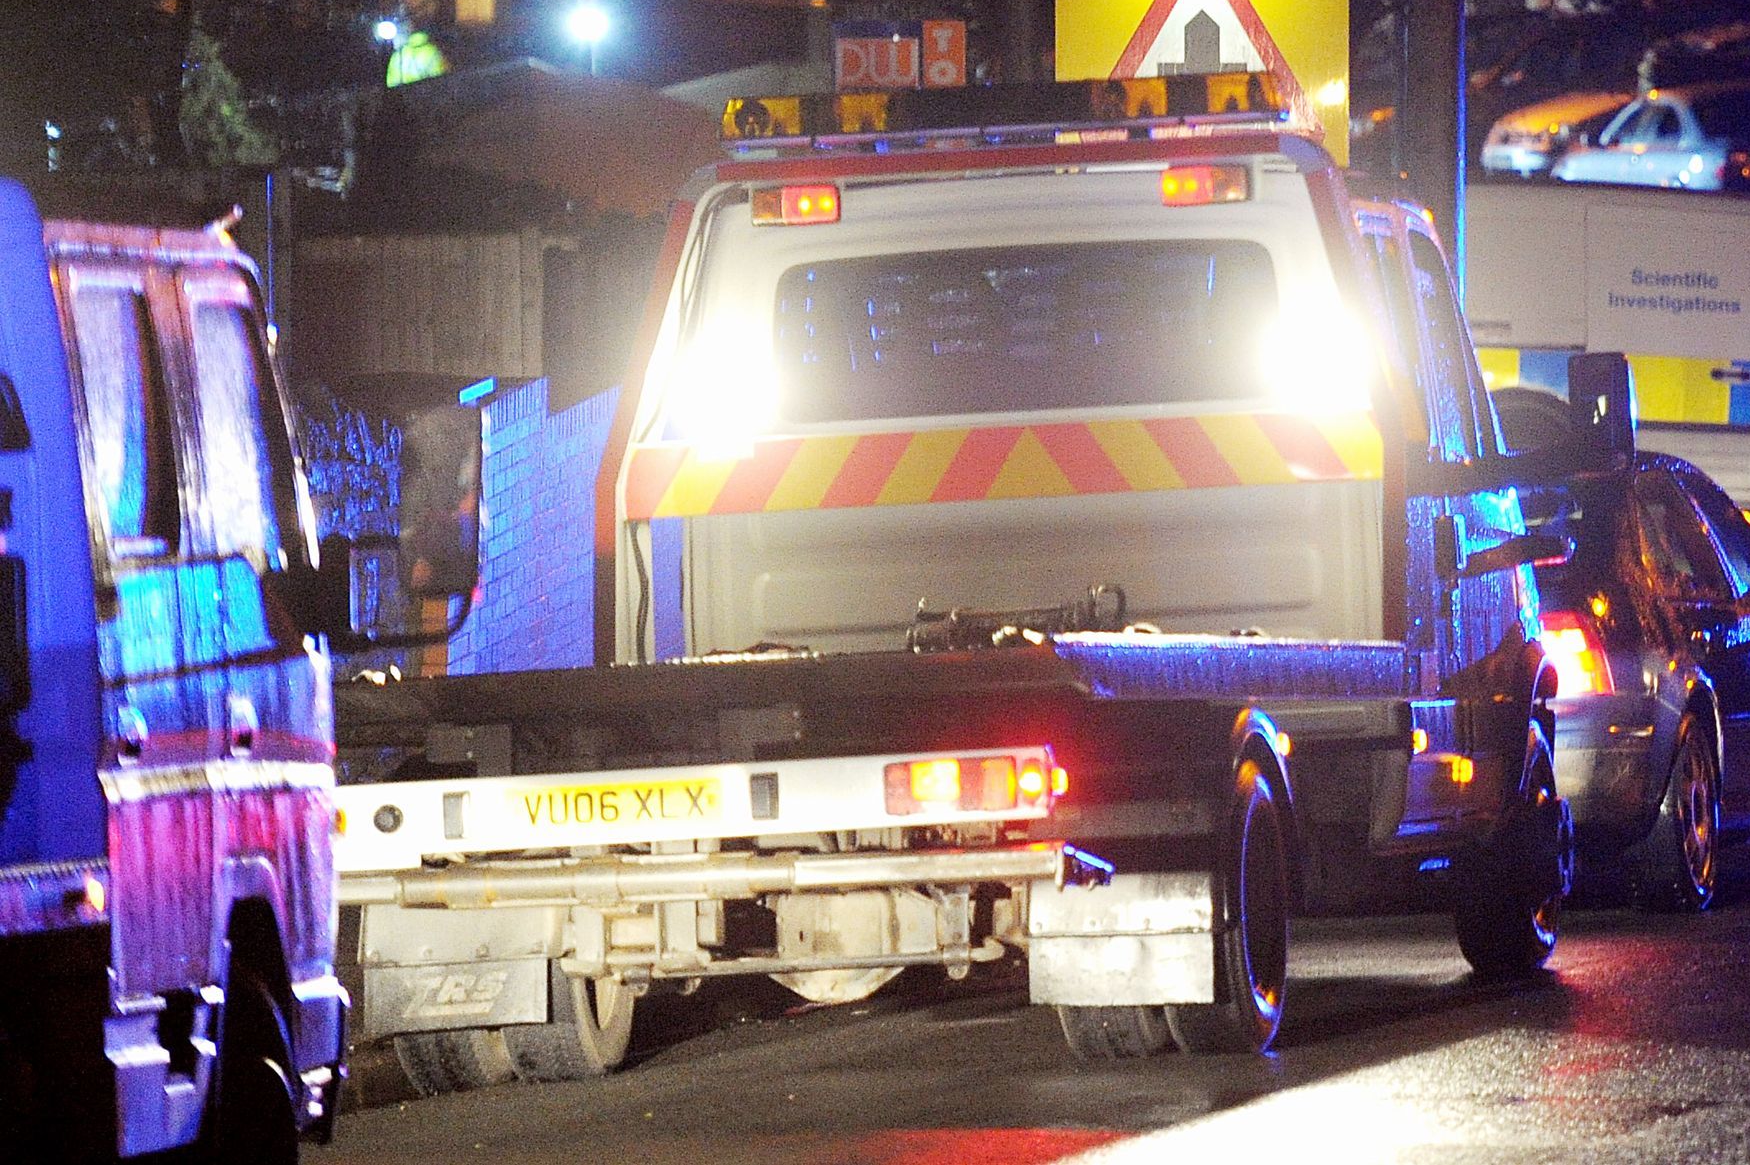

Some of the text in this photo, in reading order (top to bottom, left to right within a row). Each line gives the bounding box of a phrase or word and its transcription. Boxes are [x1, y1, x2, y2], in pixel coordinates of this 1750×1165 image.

[1631, 266, 1720, 290] Scientific
[1608, 292, 1741, 314] Investigations
[525, 786, 705, 824] VU06 XLX
